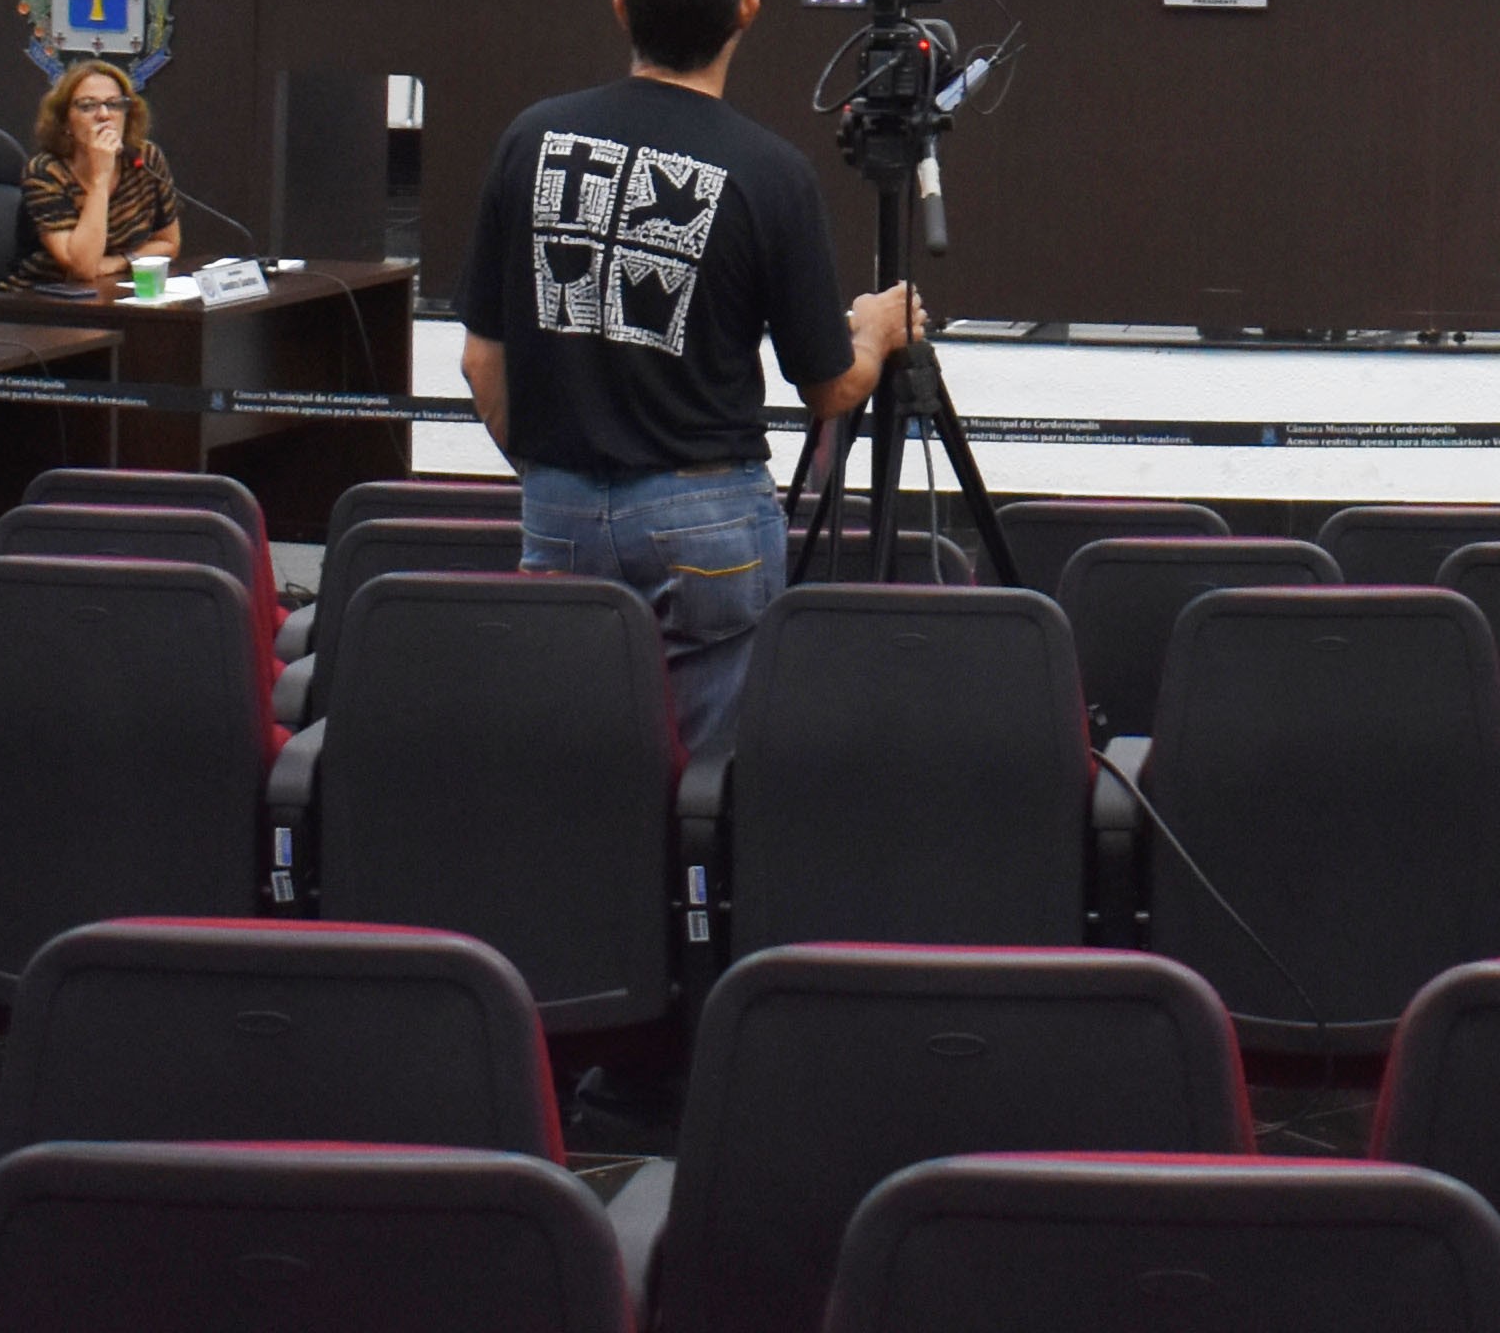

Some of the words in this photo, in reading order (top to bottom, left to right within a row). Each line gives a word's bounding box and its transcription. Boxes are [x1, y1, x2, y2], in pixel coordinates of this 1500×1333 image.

[1286, 423, 1323, 434] Câmara
[1325, 423, 1374, 436] Municipal
[1375, 424, 1388, 434] de
[1389, 423, 1456, 436] Cordeirópolis
[1286, 437, 1319, 447] Acesso
[1321, 436, 1357, 447] restrito
[1360, 438, 1394, 449] apenas
[1396, 438, 1419, 449] para
[1421, 436, 1482, 447] funcionários
